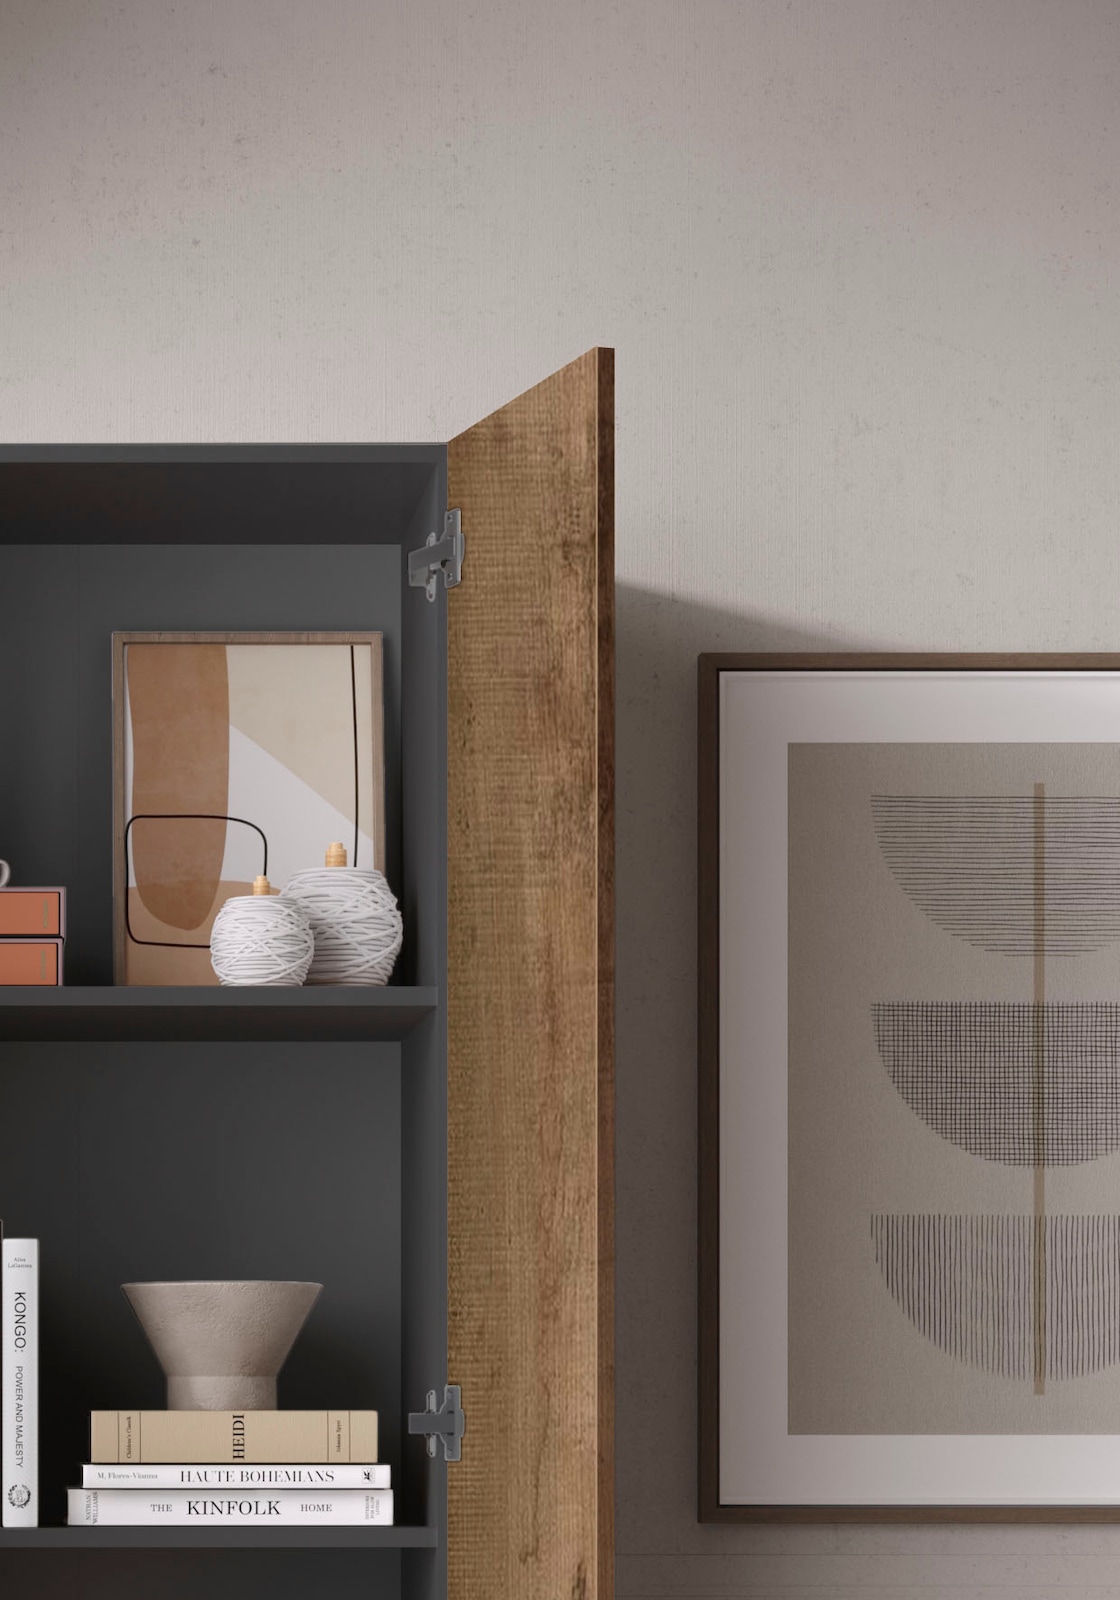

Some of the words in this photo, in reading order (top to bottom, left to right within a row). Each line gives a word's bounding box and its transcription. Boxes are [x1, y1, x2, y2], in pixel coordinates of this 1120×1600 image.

[14, 1291, 27, 1354] KONGO:
[15, 1366, 24, 1401] POWER
[15, 1402, 24, 1423] AND
[15, 1425, 24, 1468] MAJESTY
[232, 1414, 245, 1459] HEIDI
[180, 1471, 235, 1482] HAUTE
[239, 1471, 335, 1482] BOHEMIANS
[150, 1504, 173, 1512] THE
[187, 1500, 282, 1516] KINFOLK
[300, 1504, 333, 1512] HOME
